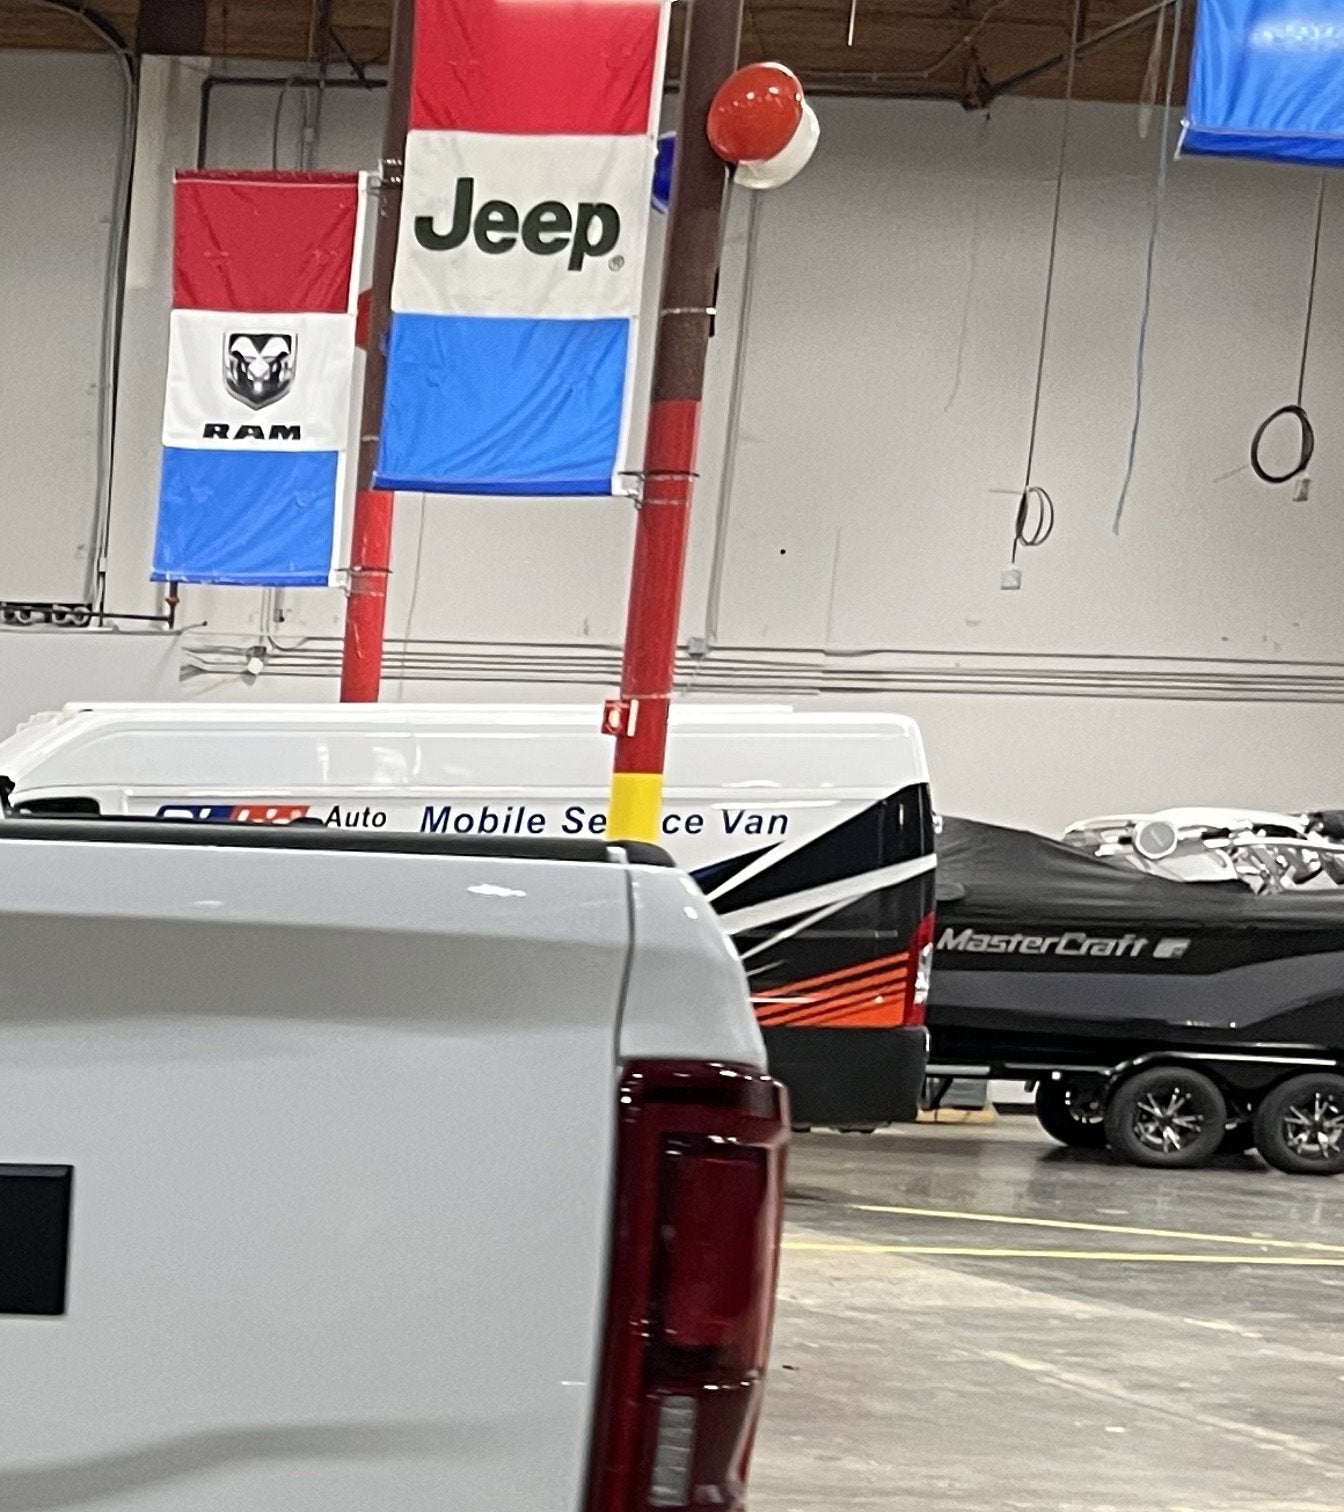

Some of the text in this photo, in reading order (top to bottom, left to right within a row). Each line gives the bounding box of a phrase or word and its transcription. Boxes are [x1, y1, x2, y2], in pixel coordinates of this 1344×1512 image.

[414, 177, 620, 271] Jeep
[203, 423, 301, 440] RAM
[325, 805, 387, 828] Auto
[419, 806, 789, 835] Mobile Sece Van
[936, 928, 1149, 957] MasterCraft
